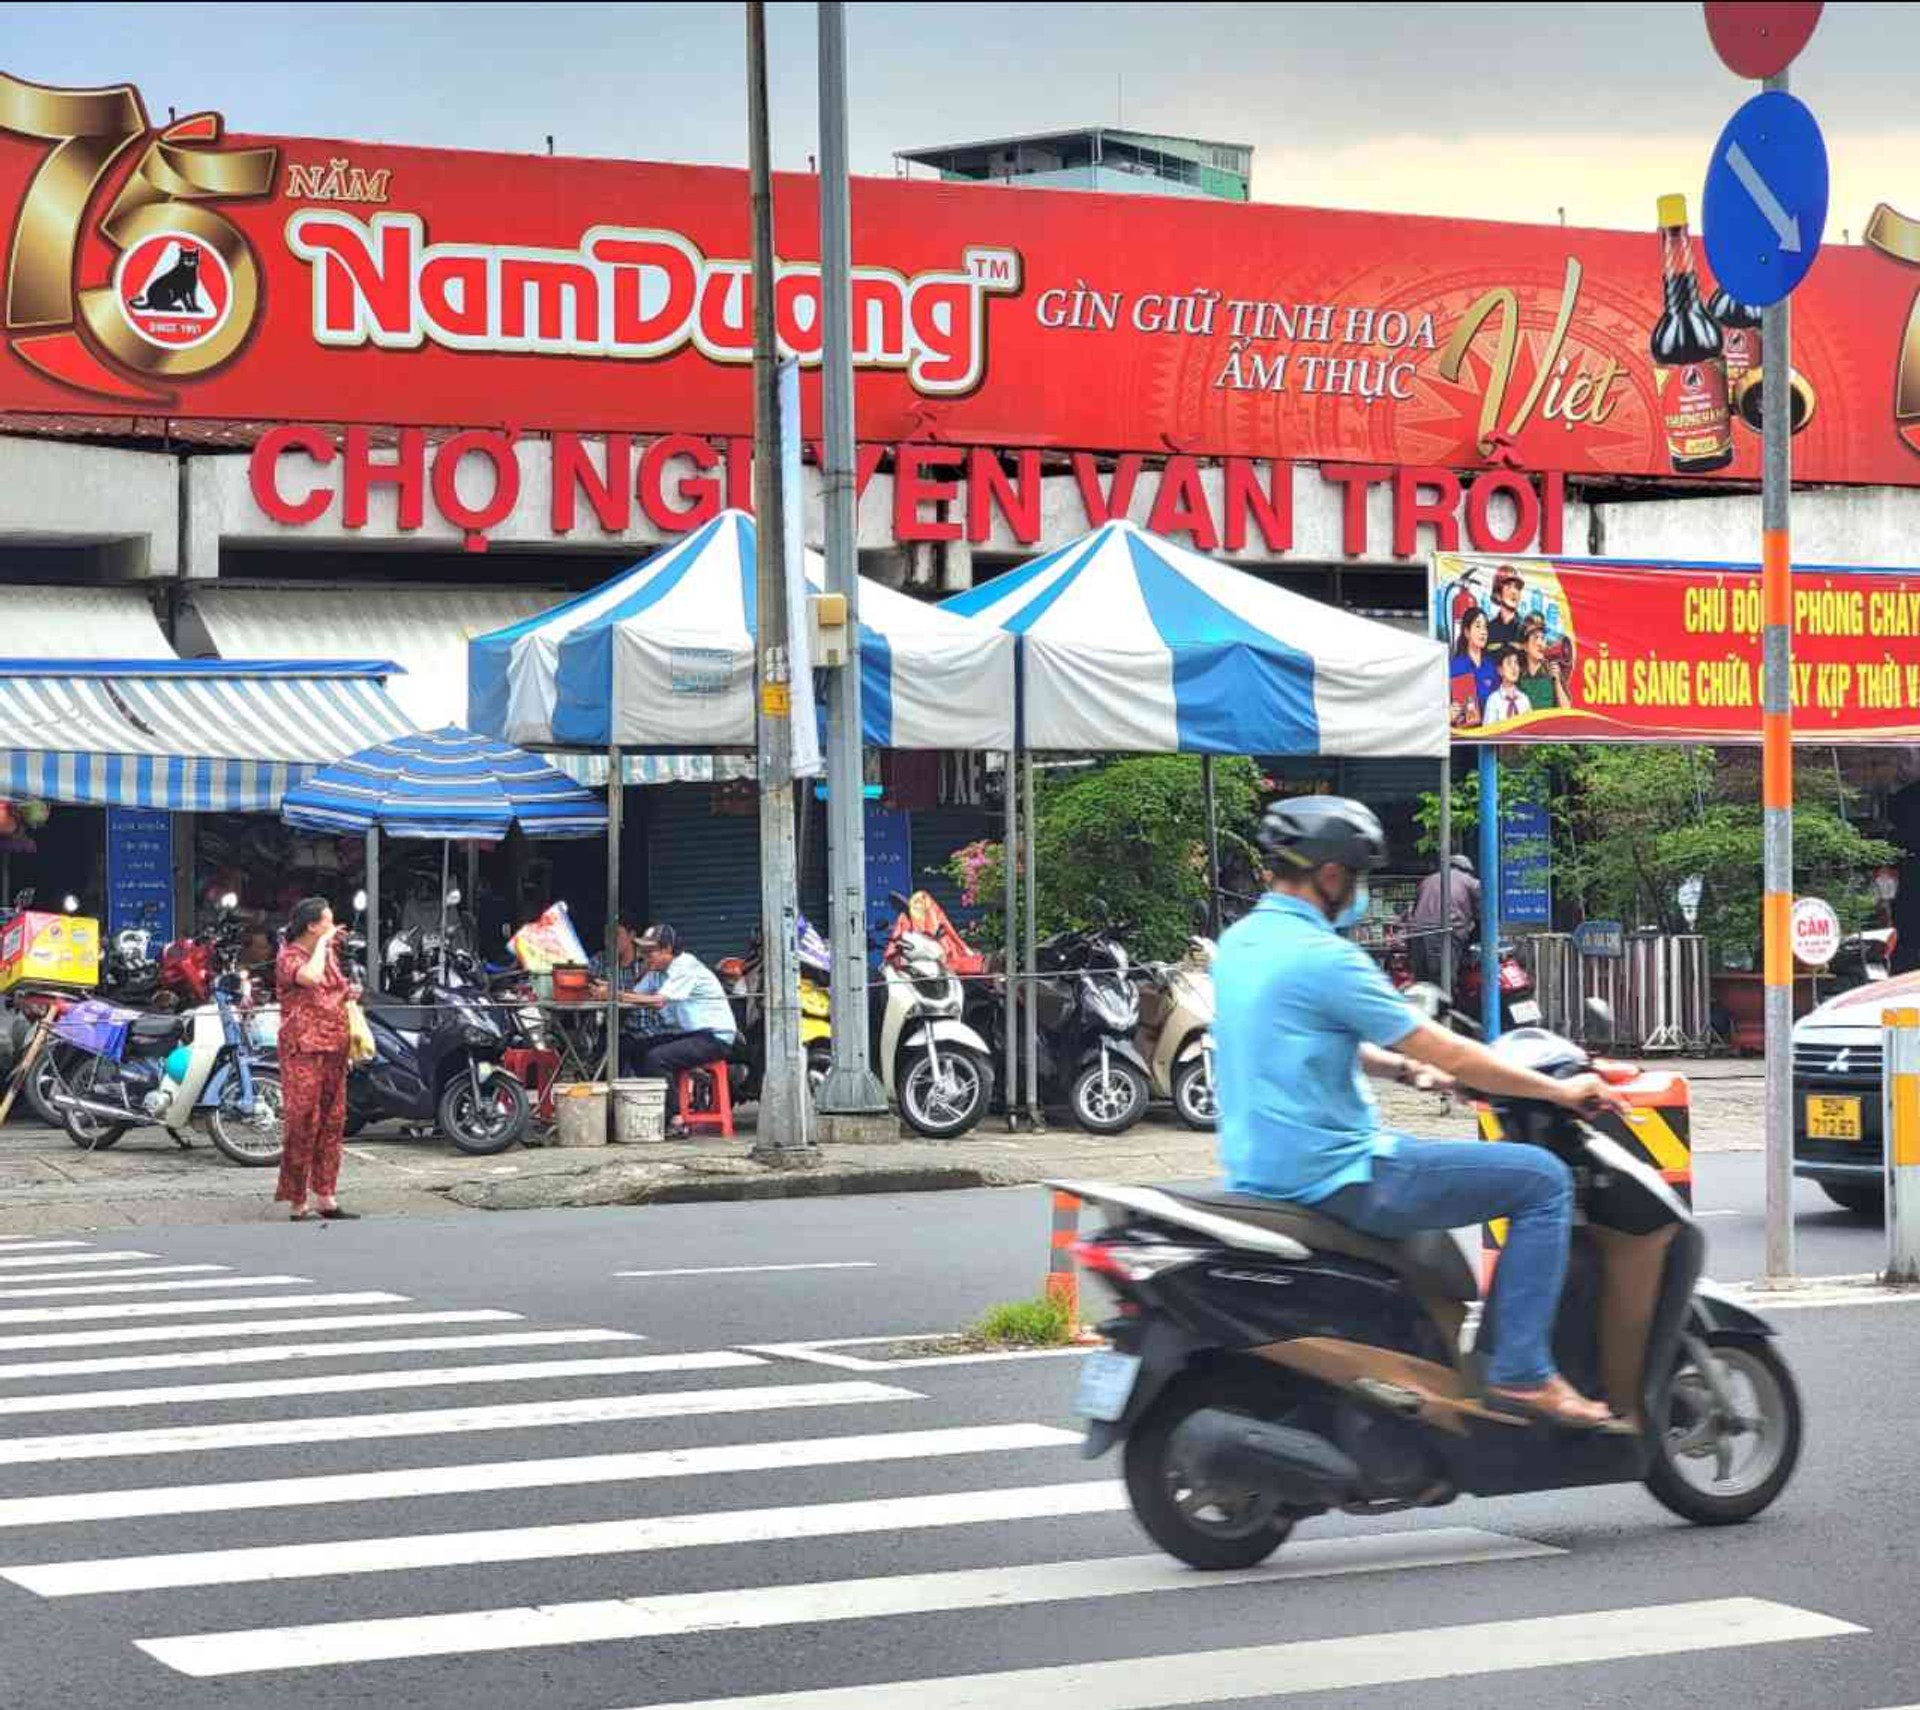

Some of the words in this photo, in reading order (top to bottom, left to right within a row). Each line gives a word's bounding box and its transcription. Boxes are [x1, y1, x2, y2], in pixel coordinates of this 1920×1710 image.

[286, 158, 392, 202] NĂM
[1035, 279, 1123, 332] GÌN
[1132, 287, 1222, 336] GIỮ
[1227, 300, 1335, 343] TINH
[1343, 308, 1438, 350] HOA
[1214, 337, 1287, 392] ẨM
[1297, 353, 1417, 404] THỰC
[1439, 254, 1631, 457] Việt
[249, 421, 521, 553] CHỢ
[1320, 431, 1564, 557] TRỖI
[1685, 574, 1727, 634] CHỦ
[1794, 579, 1864, 636] PHÒNG
[1632, 650, 1691, 706] SÀNG
[1696, 652, 1753, 707] CHỮA
[1817, 663, 1851, 719] KỊP
[1855, 651, 1901, 709] THỜI
